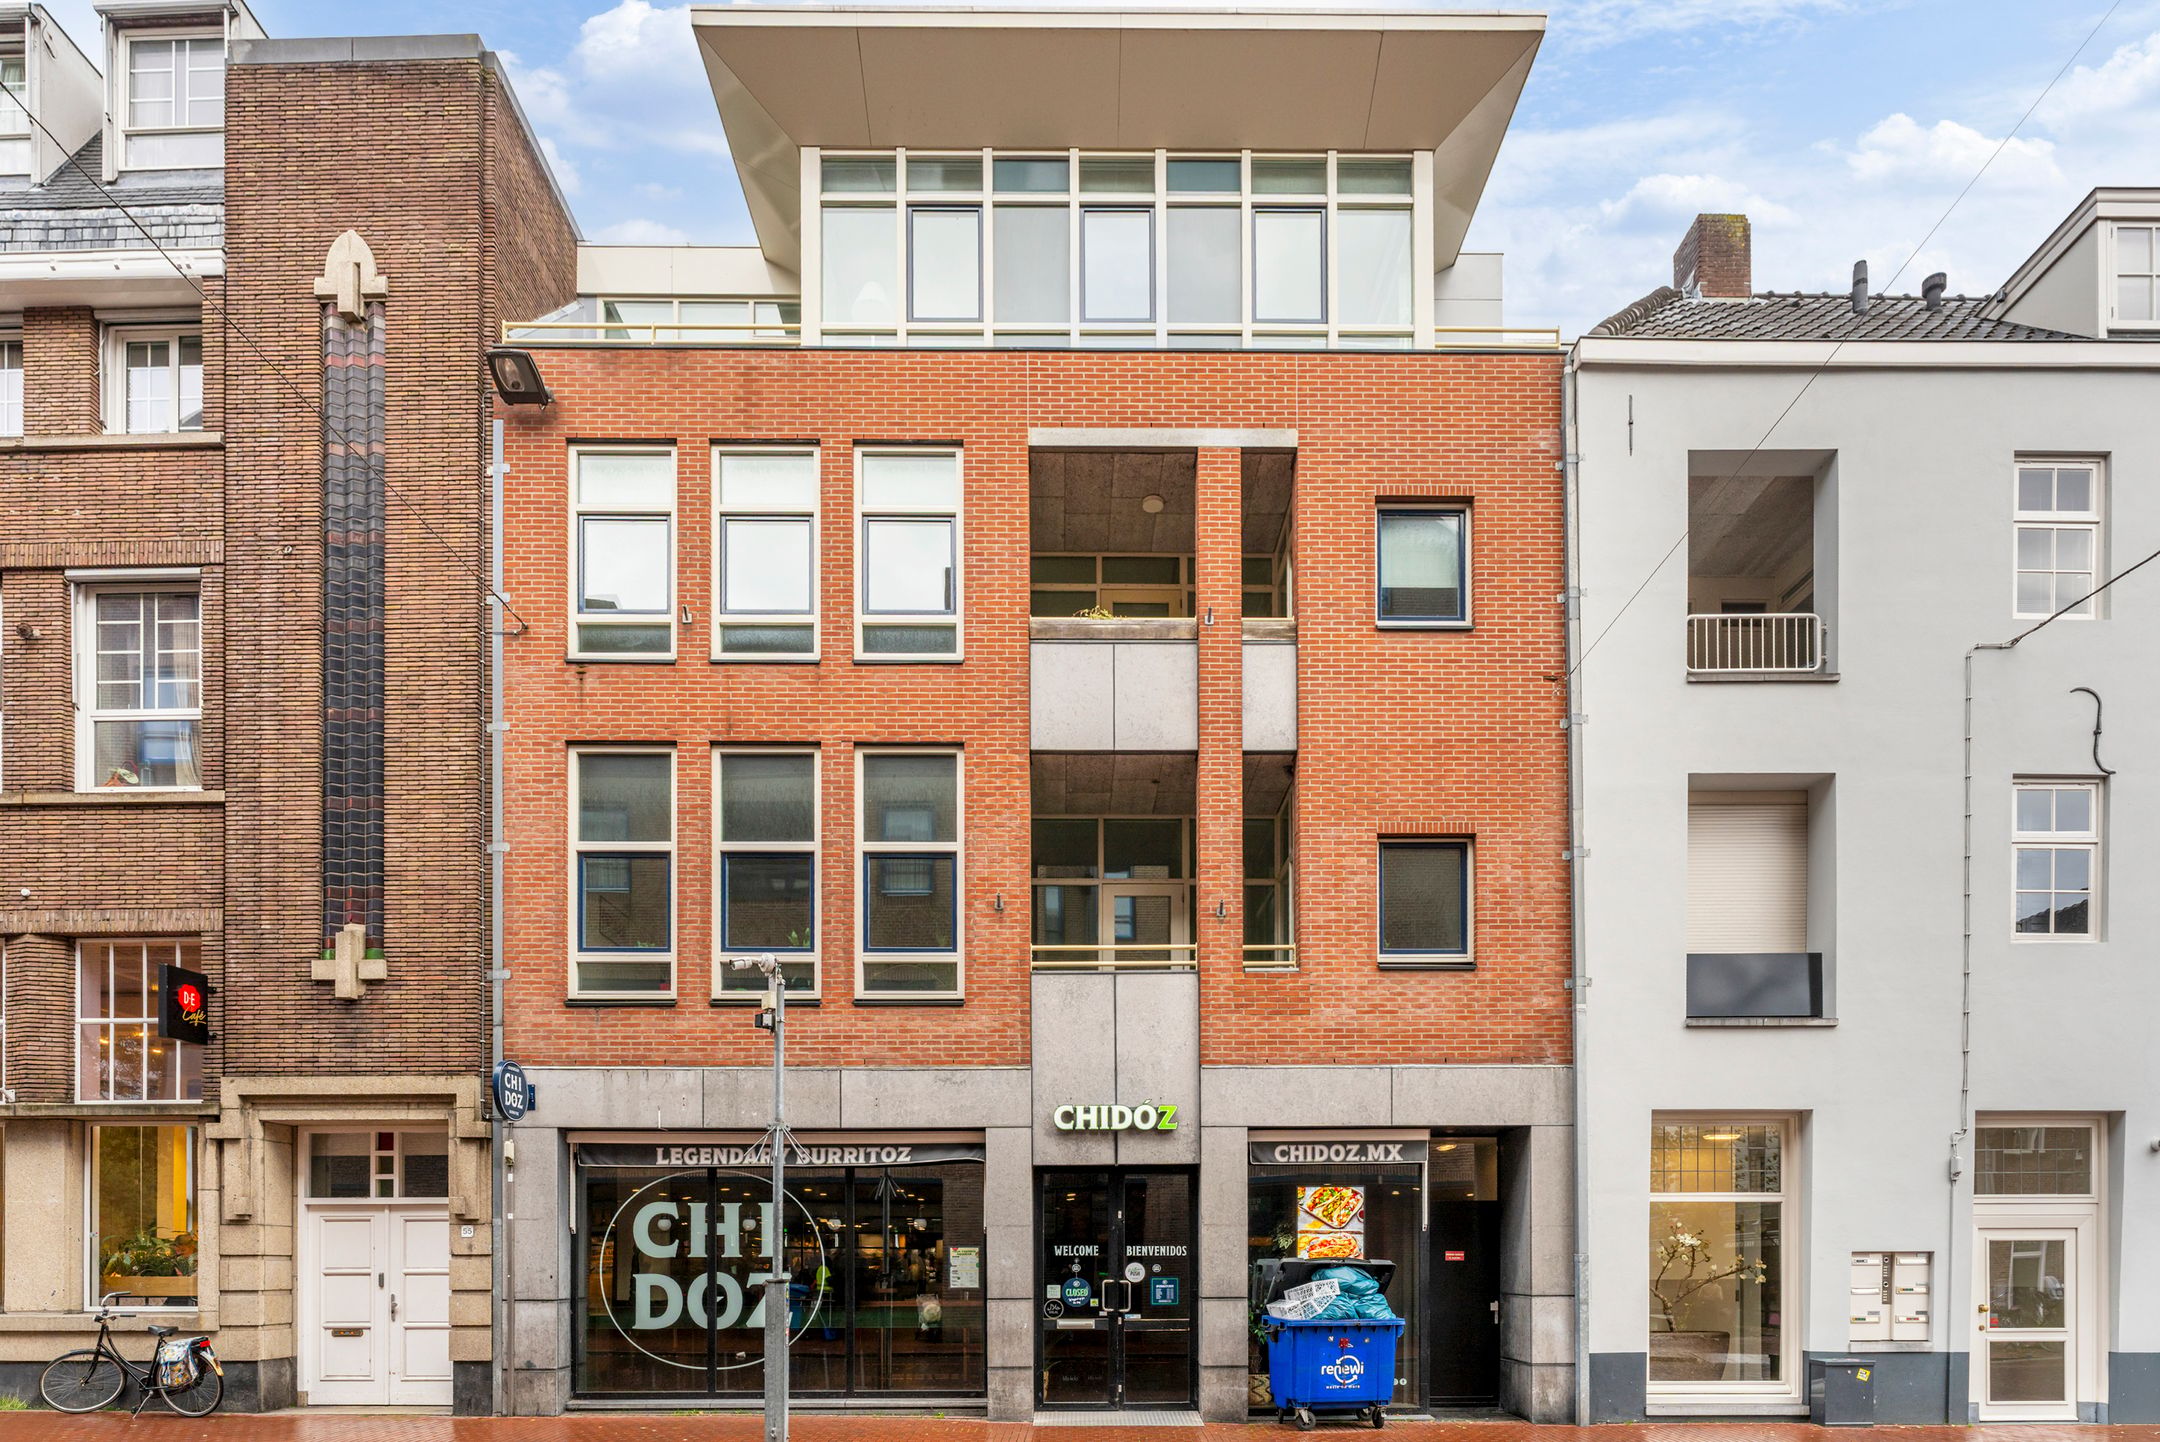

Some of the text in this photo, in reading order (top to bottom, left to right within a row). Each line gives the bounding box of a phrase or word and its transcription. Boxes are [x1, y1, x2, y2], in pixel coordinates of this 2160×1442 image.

[182, 1005, 207, 1026] Café
[504, 1072, 522, 1092] CHI
[504, 1090, 524, 1109] DOZ
[796, 1147, 912, 1165] BURRITOZ
[1274, 1144, 1404, 1162] CHIDOZ.MX
[462, 1227, 473, 1235] 55
[633, 1201, 774, 1259] CHI
[1054, 1245, 1100, 1256] WELCOME
[1126, 1245, 1187, 1257] BIENVENIDOS
[1065, 1288, 1089, 1297] CLOSED
[1321, 1361, 1364, 1375] renewi
